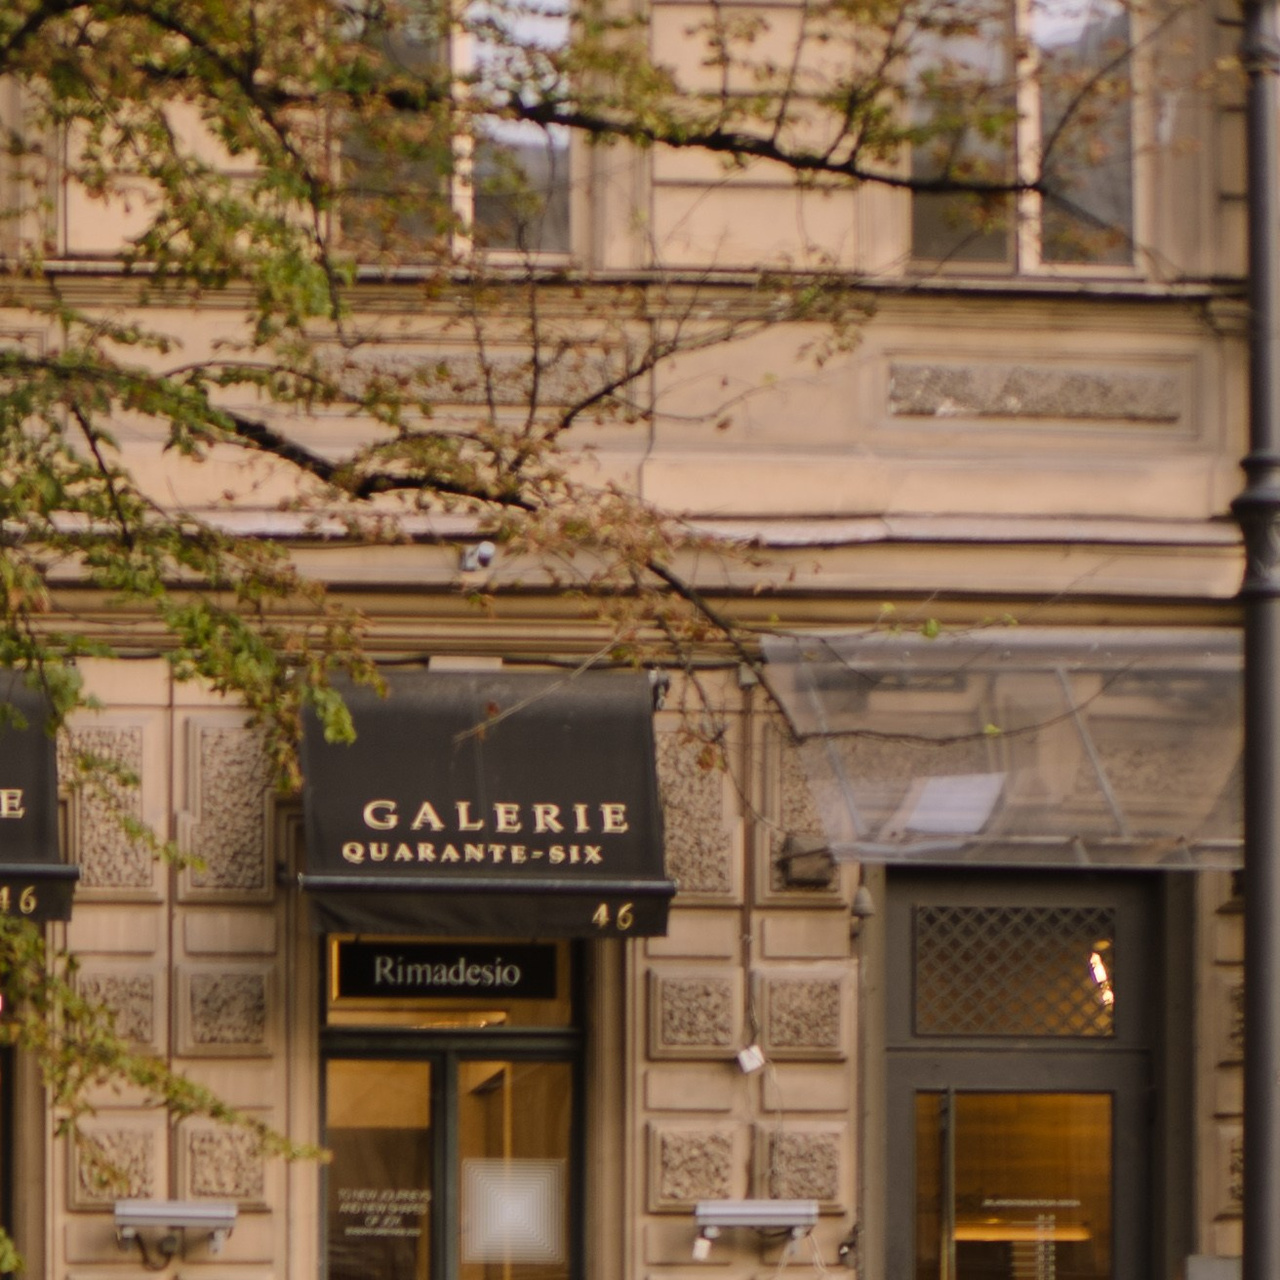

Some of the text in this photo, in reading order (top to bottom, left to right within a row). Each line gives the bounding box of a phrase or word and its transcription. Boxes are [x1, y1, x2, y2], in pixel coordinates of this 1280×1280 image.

[363, 800, 629, 833] GALERIE
[342, 841, 603, 865] QUARANTE-SIX
[591, 903, 634, 931] 46
[374, 956, 521, 986] Rimadesio
